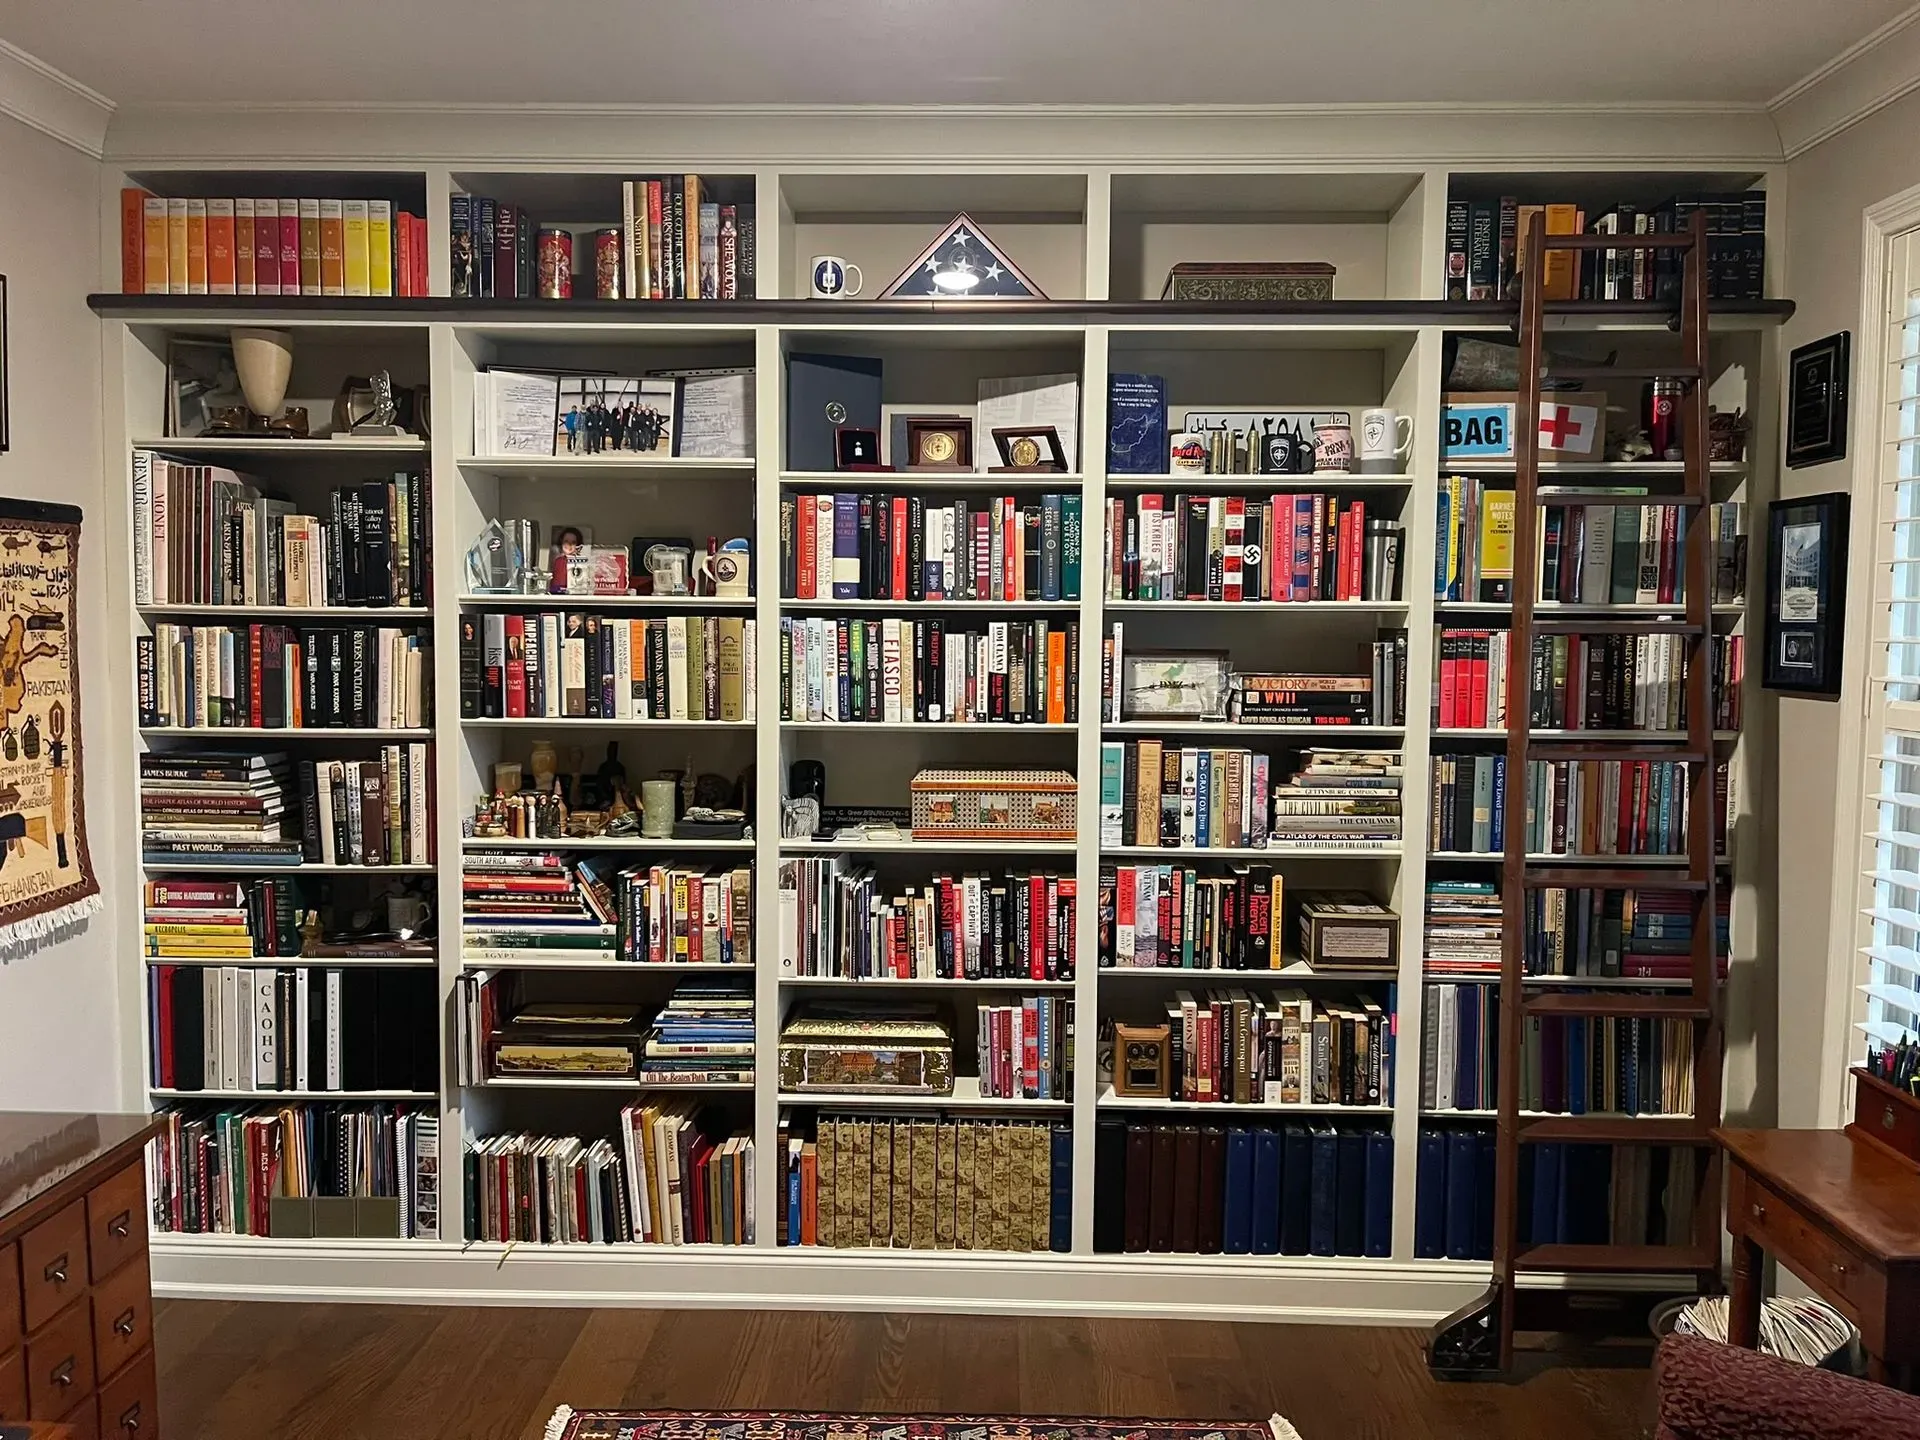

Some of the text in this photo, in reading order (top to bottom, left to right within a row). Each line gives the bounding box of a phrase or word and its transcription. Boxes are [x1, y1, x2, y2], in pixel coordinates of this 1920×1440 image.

[634, 215, 646, 257] Narnia
[662, 205, 673, 233] WARS
[674, 193, 684, 278] FOUR GOTHIC KINGS
[1472, 217, 1483, 273] LITERATURE
[1482, 217, 1491, 259] ENGLISH
[1445, 416, 1504, 447] BAG
[412, 476, 420, 507] VINCENT
[154, 493, 165, 543] MONET
[353, 492, 361, 543] METROPOLITAN
[412, 507, 420, 517] by
[878, 509, 887, 542] SPYCRAFT
[1044, 506, 1054, 537] SECRETS
[1282, 506, 1290, 518] THE
[1282, 519, 1290, 535] GUNS
[1312, 497, 1323, 533] COUNTDOWN
[223, 520, 232, 577] ARTS IDEAS
[805, 498, 815, 568] WAR DECISION
[824, 517, 833, 585] PLAN OF ATTACK
[1063, 520, 1071, 557] BURTON
[1150, 512, 1162, 554] OSTKRIEG
[1312, 535, 1322, 553] 1945
[818, 536, 826, 586] WOODWARD
[911, 533, 923, 585] George Tenet
[1283, 560, 1291, 577] LIGHT
[59, 632, 69, 670] CHINA
[524, 619, 539, 672] IMPEACHED
[806, 626, 815, 653] CASUALTY
[826, 628, 836, 671] NO EASY DAY
[837, 626, 850, 678] UNDER FIRE
[929, 630, 940, 667] FIREFIGHT
[995, 625, 1005, 642] TOM
[1625, 634, 1635, 666] HAILEY'S
[196, 650, 204, 668] LAKE
[813, 631, 821, 702] FIRST TOBY
[884, 638, 901, 696] FIASCO
[994, 643, 1005, 673] CLANCY
[1103, 642, 1111, 668] WORLD
[26, 680, 71, 698] PAKISTAN
[140, 640, 150, 710] DAVE BARRY
[1010, 654, 1018, 703] HISTORY CIA
[1055, 665, 1064, 703] GHOST WARS
[1256, 678, 1310, 690] VICTORY
[1263, 691, 1297, 705] WWII
[1258, 716, 1329, 725] DOUGLAS THIS
[141, 769, 189, 779] JAMES BURKE
[1198, 772, 1208, 813] GRAY FOX
[1227, 752, 1241, 803] GETTYSBURG
[1495, 761, 1504, 809] God So Loved
[413, 761, 422, 840] NATIVE AMERICANS
[1283, 801, 1322, 815] THE CIVIL
[1339, 817, 1396, 825] THE CIVIL WAR
[172, 843, 224, 852] PAST WORLDS
[464, 857, 508, 865] SOUTH AFRICA
[634, 893, 642, 911] Egypt
[1142, 869, 1152, 902] VIETNAM
[967, 884, 977, 939] OUT CAPTIVITY
[981, 889, 990, 935] GATEKEEPER
[1171, 870, 1182, 946] EVERYTHING WE HAD
[1248, 893, 1261, 936] Interval
[1258, 894, 1271, 936] Decent
[154, 925, 187, 934] NECROPOLIS
[895, 915, 907, 953] FIRST IN
[484, 952, 518, 960] EGYPT
[260, 983, 274, 1064] CAOHC
[1222, 1009, 1230, 1068] CLARENCE THOMAS
[1236, 1006, 1249, 1074] Alan Greenspan
[1315, 1034, 1330, 1071] Stanley
[260, 1152, 270, 1172] ACLS
[667, 1129, 675, 1163] COMPASS
